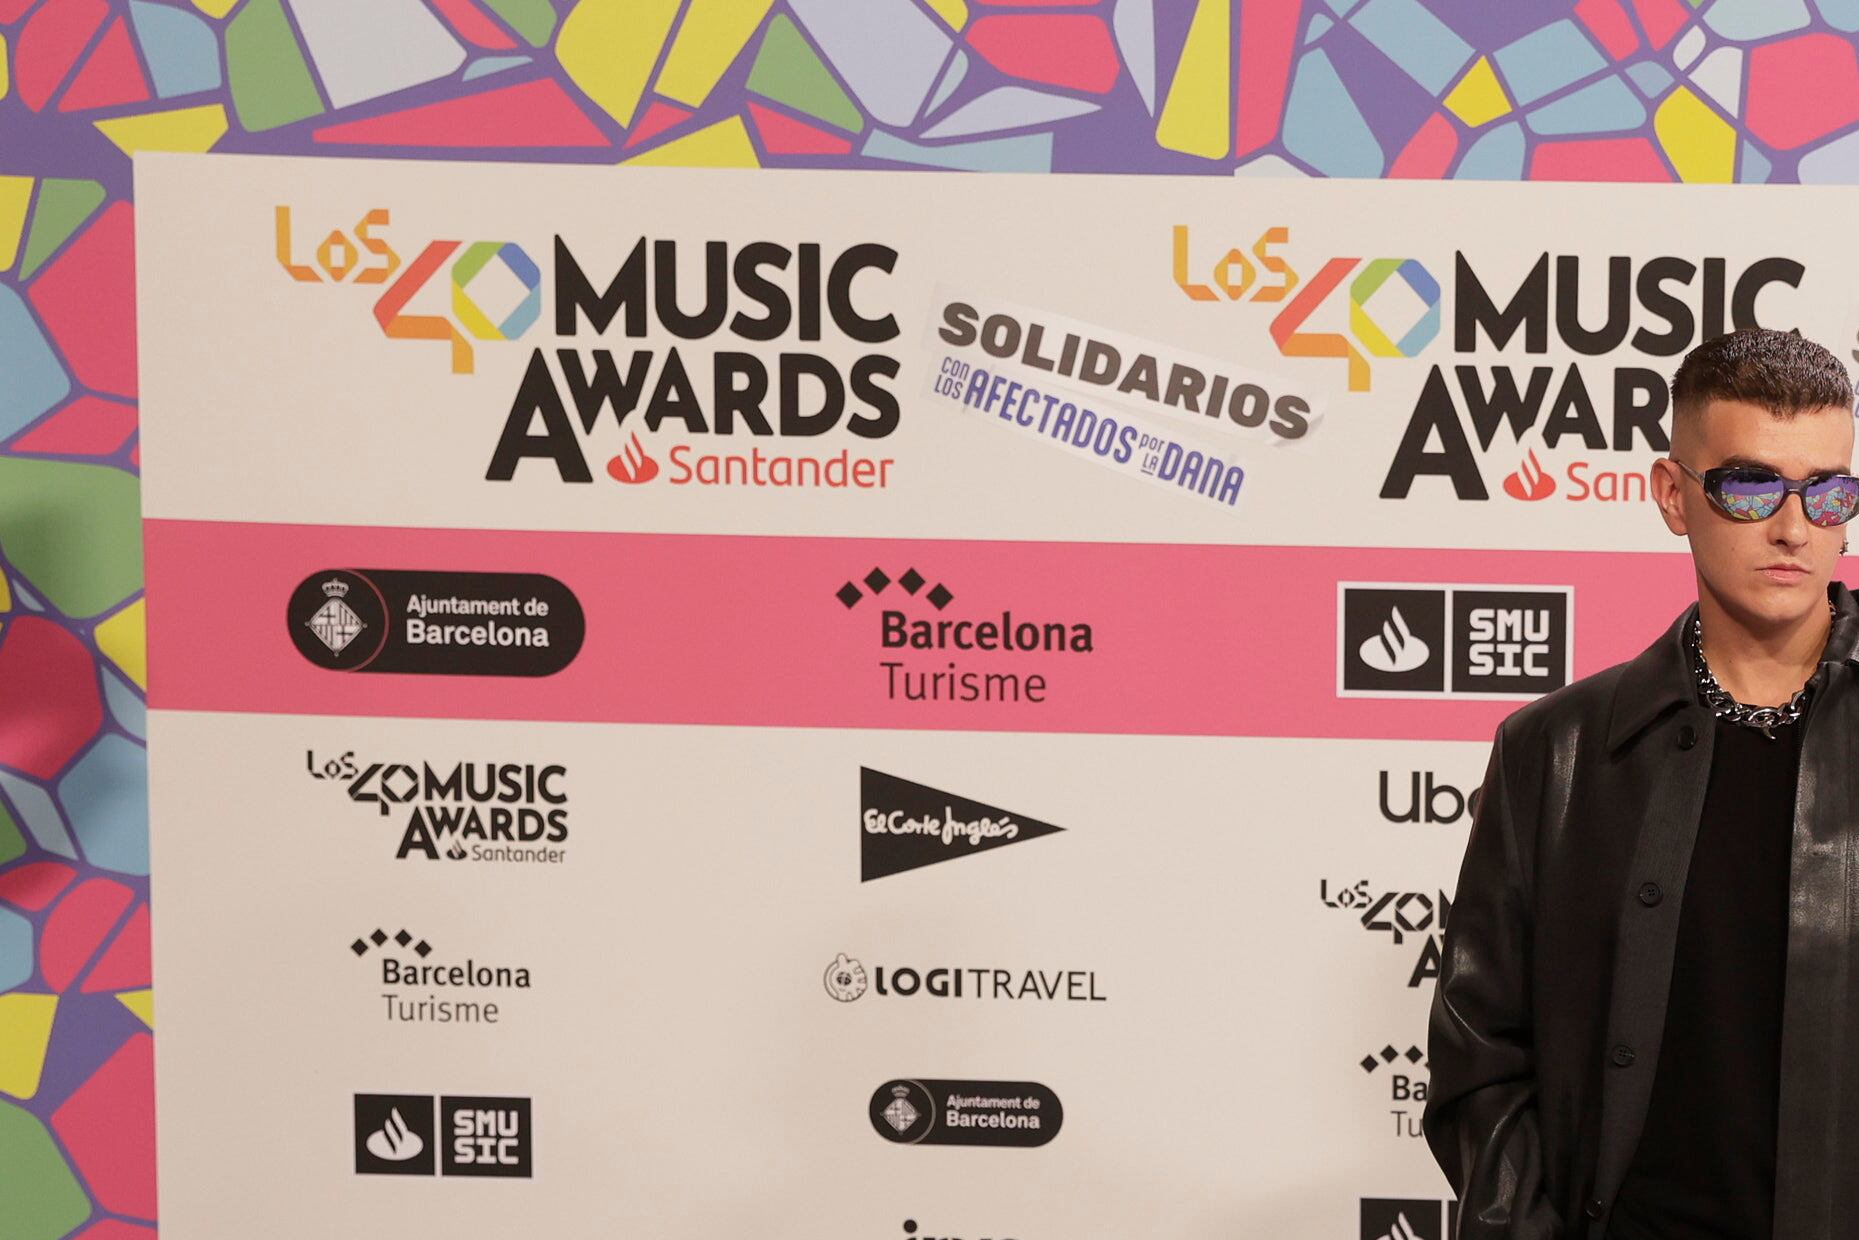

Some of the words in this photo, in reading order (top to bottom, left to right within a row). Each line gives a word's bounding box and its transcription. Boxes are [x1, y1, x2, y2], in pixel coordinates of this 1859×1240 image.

[372, 240, 541, 375] 40
[553, 233, 900, 344] MUSIC
[1268, 257, 1441, 392] 40
[938, 302, 1311, 440] SOLIDARIOS
[485, 346, 901, 483] AWARDS
[1379, 362, 1670, 500] AWAR
[963, 367, 1136, 465] AFECTADOS
[1157, 440, 1245, 507] DANA
[668, 445, 894, 488] Santander
[406, 594, 519, 619] Ajuntament
[523, 598, 549, 617] de
[406, 619, 550, 648] Barcelona
[881, 610, 1094, 652] Barcelona
[880, 662, 1047, 702] Turisme
[347, 763, 419, 816] 40
[424, 760, 568, 804] MUSIC
[396, 806, 568, 860] AWARDS
[471, 845, 566, 864] Santander
[382, 958, 531, 988] Barcelona
[875, 966, 1107, 1001] LOGITRAVEL
[382, 994, 499, 1023] Turisme
[946, 1094, 1021, 1111] Ajuntament
[1023, 1096, 1040, 1110] de
[946, 1111, 1041, 1130] Barcelona
